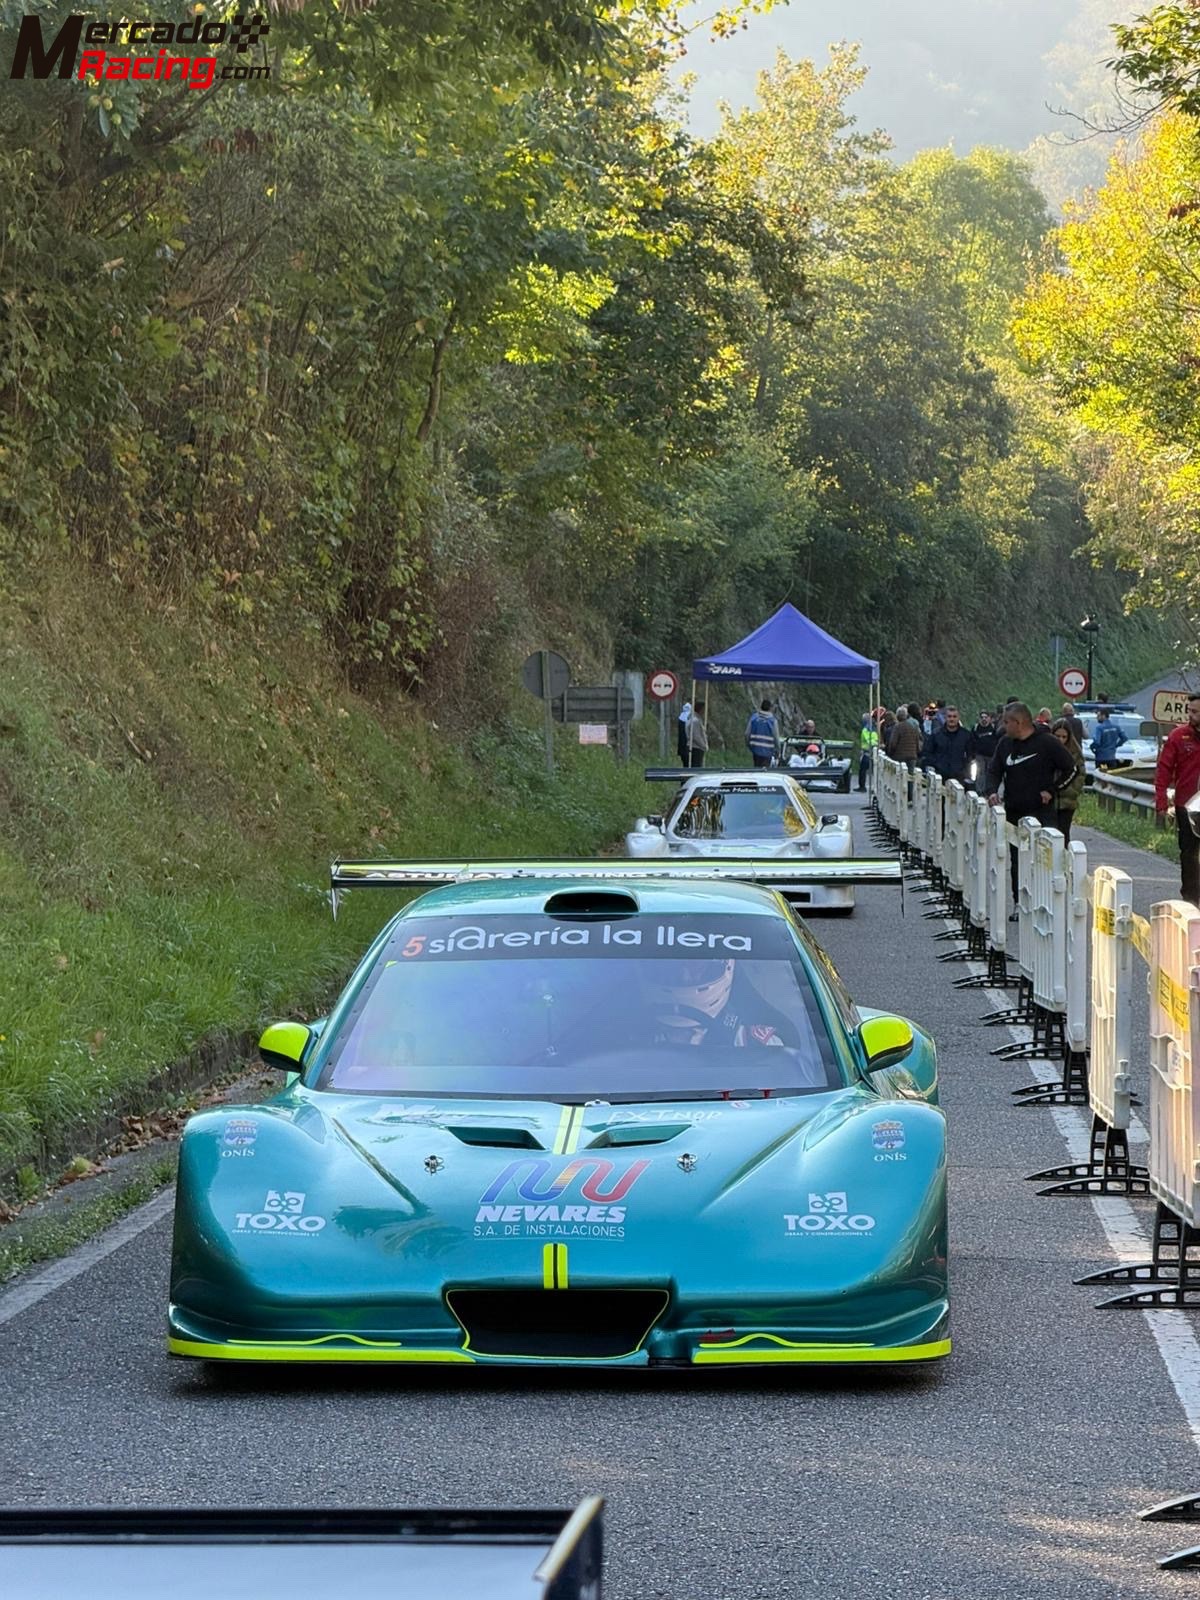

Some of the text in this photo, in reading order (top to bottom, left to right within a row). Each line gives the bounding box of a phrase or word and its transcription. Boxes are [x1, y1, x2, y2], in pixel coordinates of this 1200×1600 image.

[402, 936, 426, 957] 5
[603, 925, 642, 945] la
[657, 926, 752, 951] llera
[235, 1213, 326, 1232] TOXO
[475, 1205, 627, 1223] NEVARES
[784, 1214, 876, 1231] TOXO
[473, 1224, 625, 1237] S.A. DE INSTALACIONES
